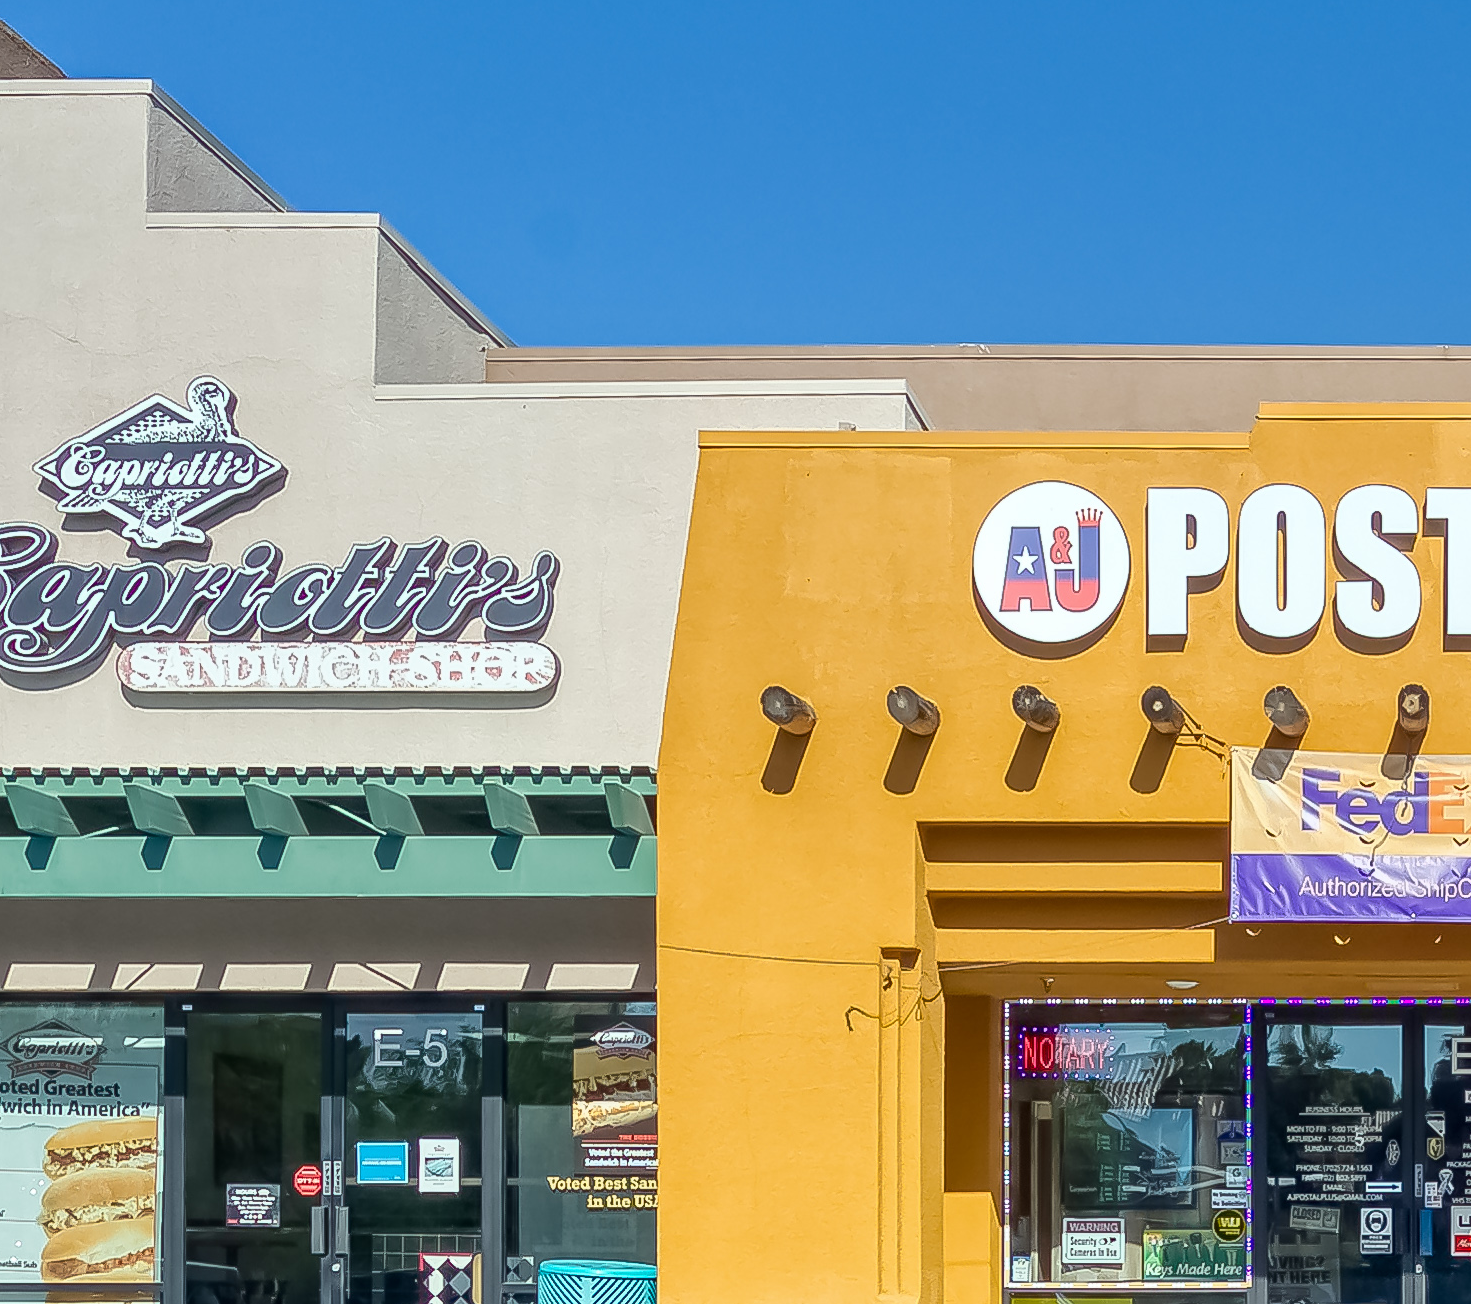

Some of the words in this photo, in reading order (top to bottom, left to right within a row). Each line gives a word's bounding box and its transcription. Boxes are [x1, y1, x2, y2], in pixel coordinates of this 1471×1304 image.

[59, 443, 259, 496] Capriotti's
[998, 524, 1103, 613] A&J
[130, 645, 398, 690] SANDWICH
[1298, 875, 1406, 898] Authorized
[373, 1027, 449, 1068] E-5
[1023, 1036, 1110, 1070] NOTARY
[43, 1079, 121, 1098] Greatest
[46, 1098, 63, 1116] in
[546, 1175, 591, 1193] Voted
[593, 1175, 628, 1192] Best
[586, 1194, 605, 1209] in
[605, 1194, 631, 1209] the
[1068, 1222, 1119, 1233] WARNING
[1069, 1236, 1097, 1248] Security
[1069, 1248, 1097, 1257] Cameras
[23, 1259, 38, 1269] Sub
[1145, 1262, 1174, 1279] Keys
[1175, 1262, 1212, 1276] Made
[1213, 1262, 1243, 1276] Here
